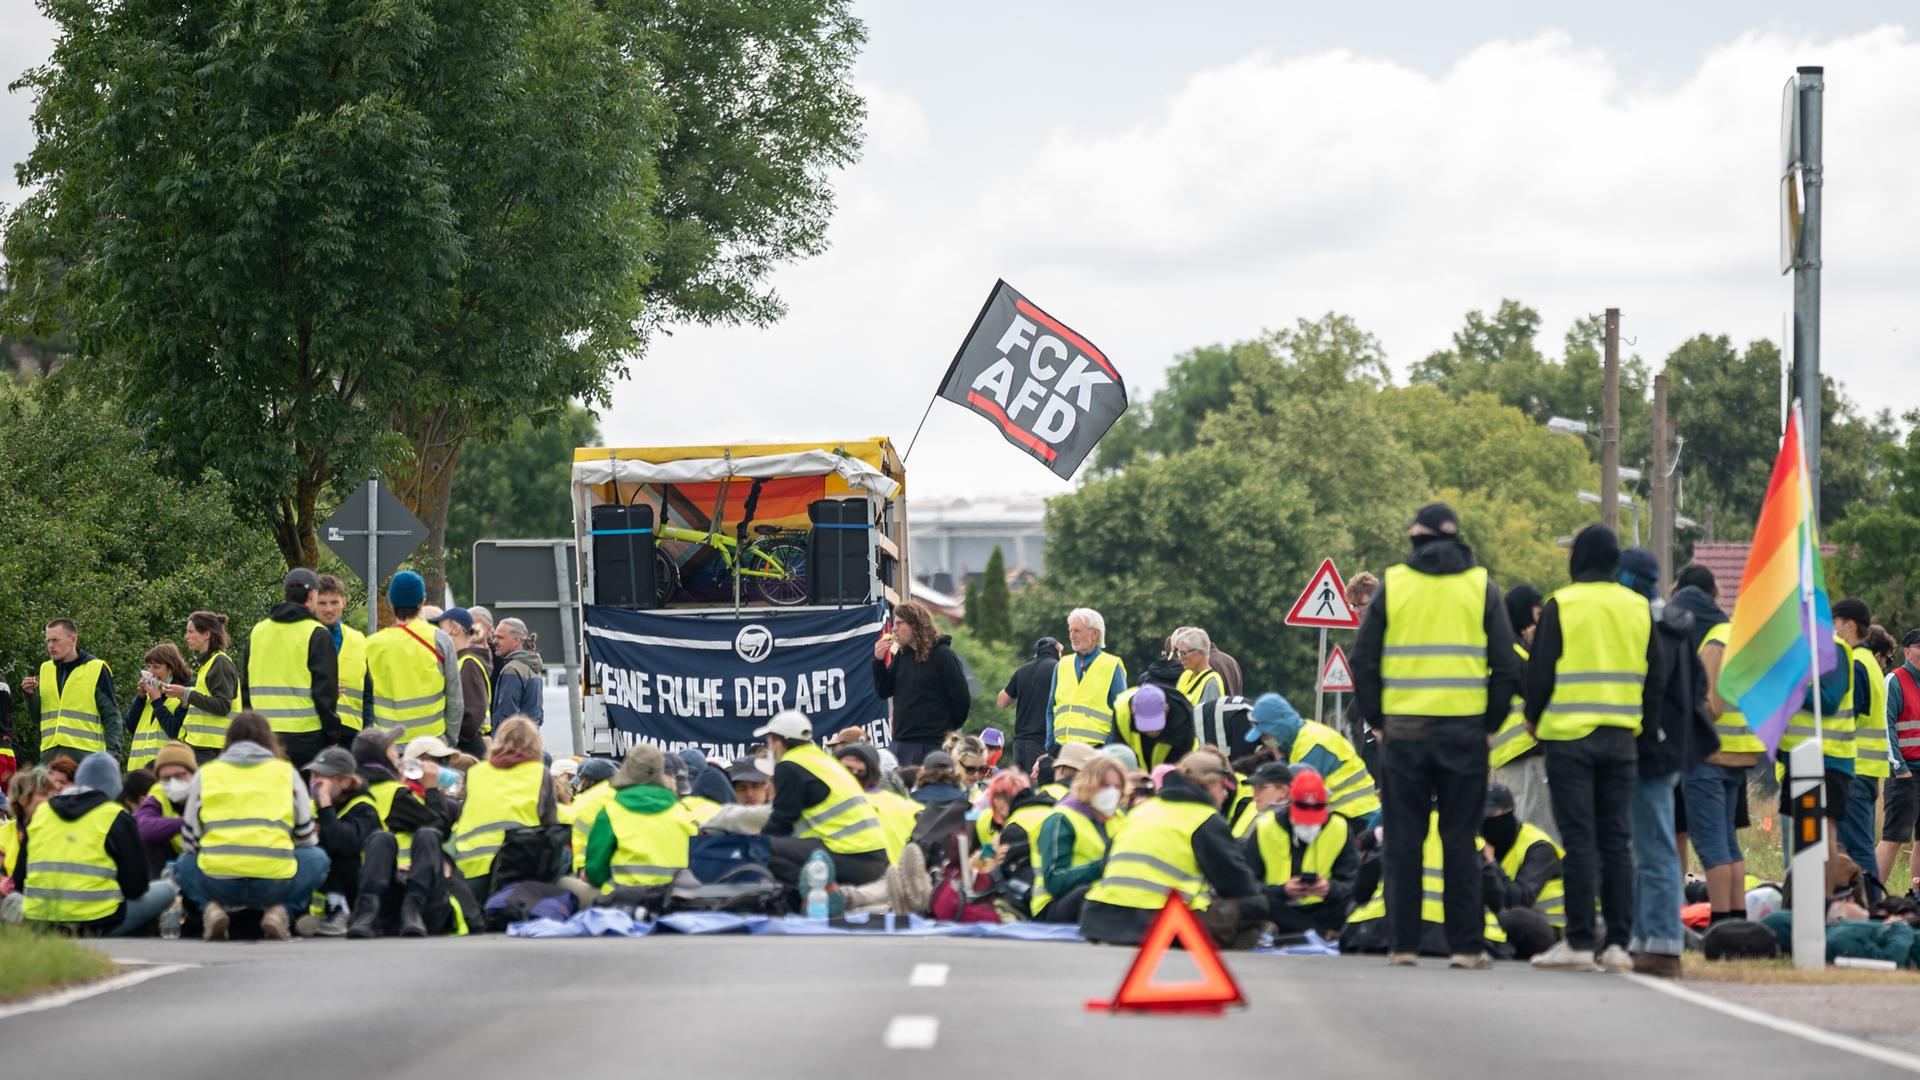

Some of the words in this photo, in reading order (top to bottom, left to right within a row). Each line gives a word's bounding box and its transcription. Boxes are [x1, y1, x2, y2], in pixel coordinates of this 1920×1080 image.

[971, 357, 1077, 444] AFD
[996, 314, 1113, 412] FCK
[656, 674, 724, 718] RUHE
[734, 677, 786, 717] DER
[795, 668, 846, 714] AFD
